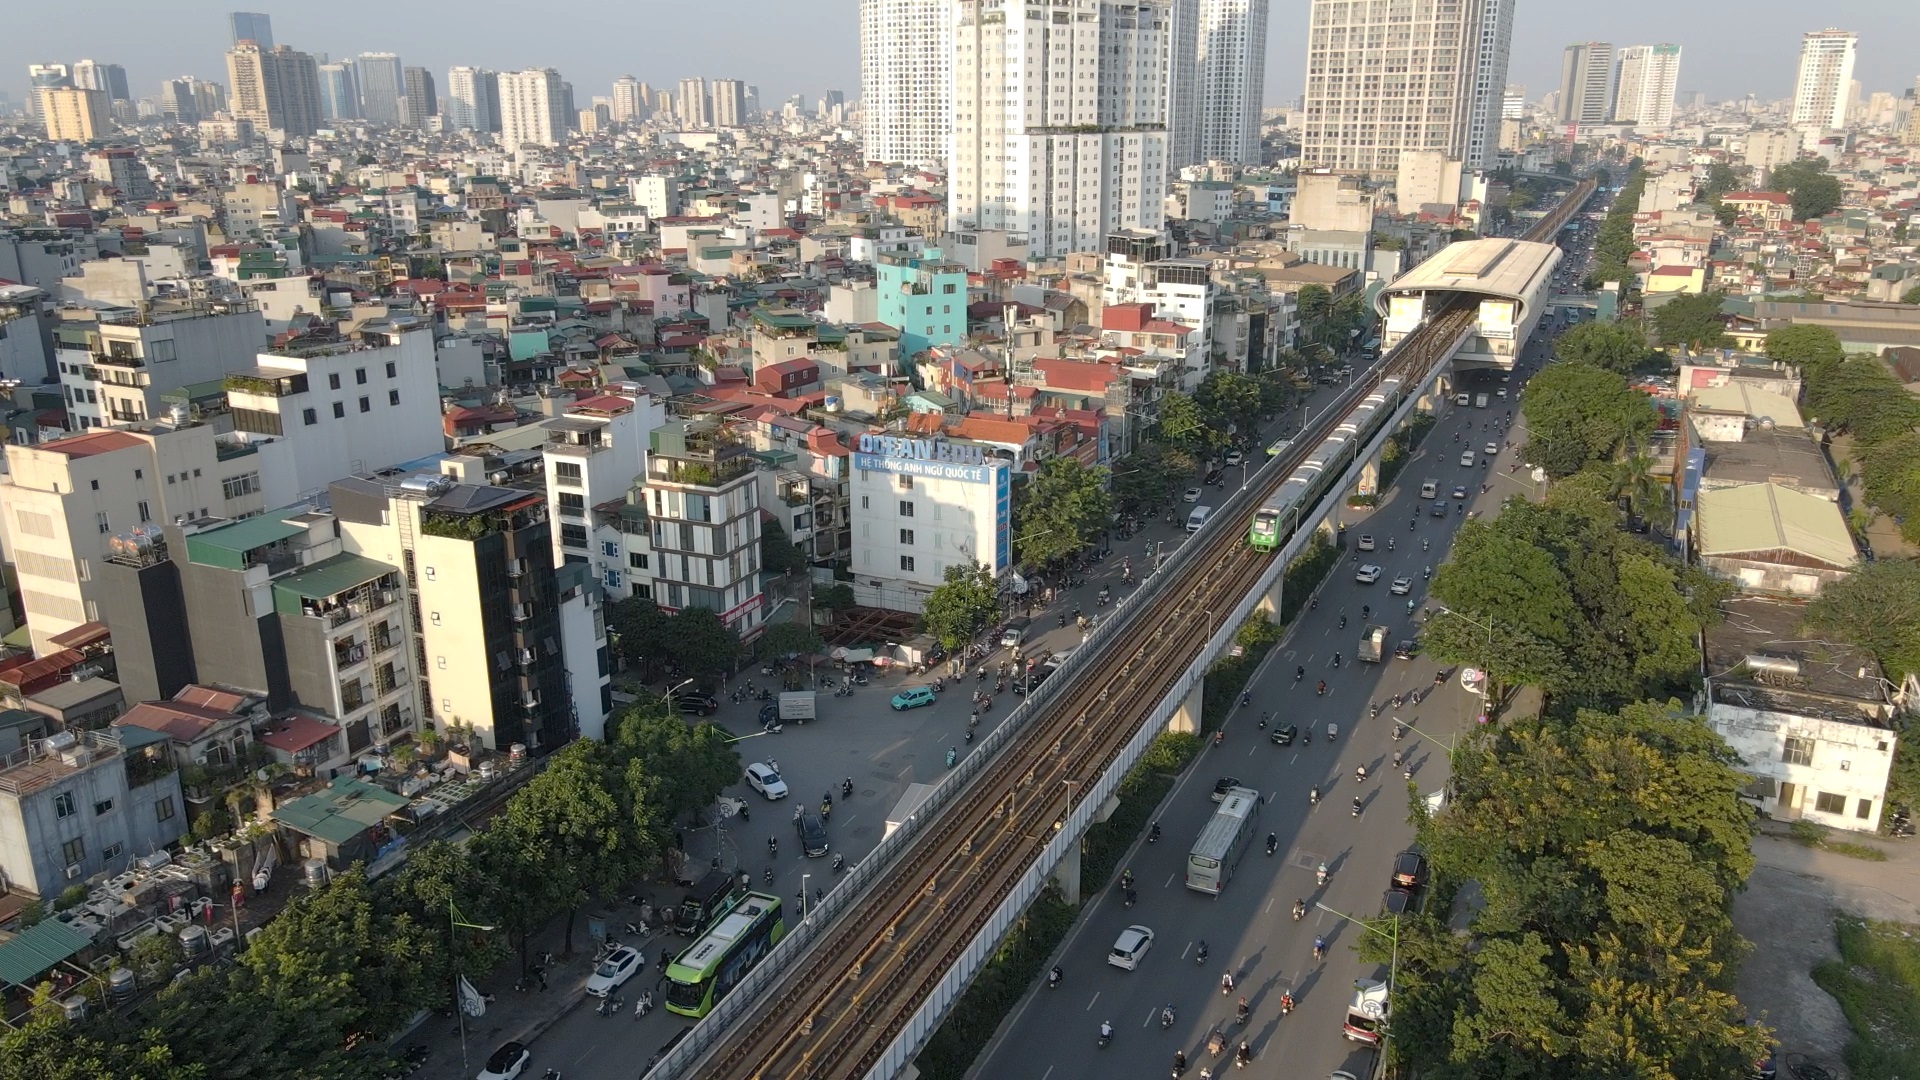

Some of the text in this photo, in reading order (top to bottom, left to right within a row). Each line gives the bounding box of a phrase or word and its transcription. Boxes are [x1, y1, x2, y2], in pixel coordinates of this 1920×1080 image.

[859, 433, 983, 466] OCEAN EDU
[860, 456, 982, 481] HỆ THỐNG ANH NGỮ QUỐC TẾ
